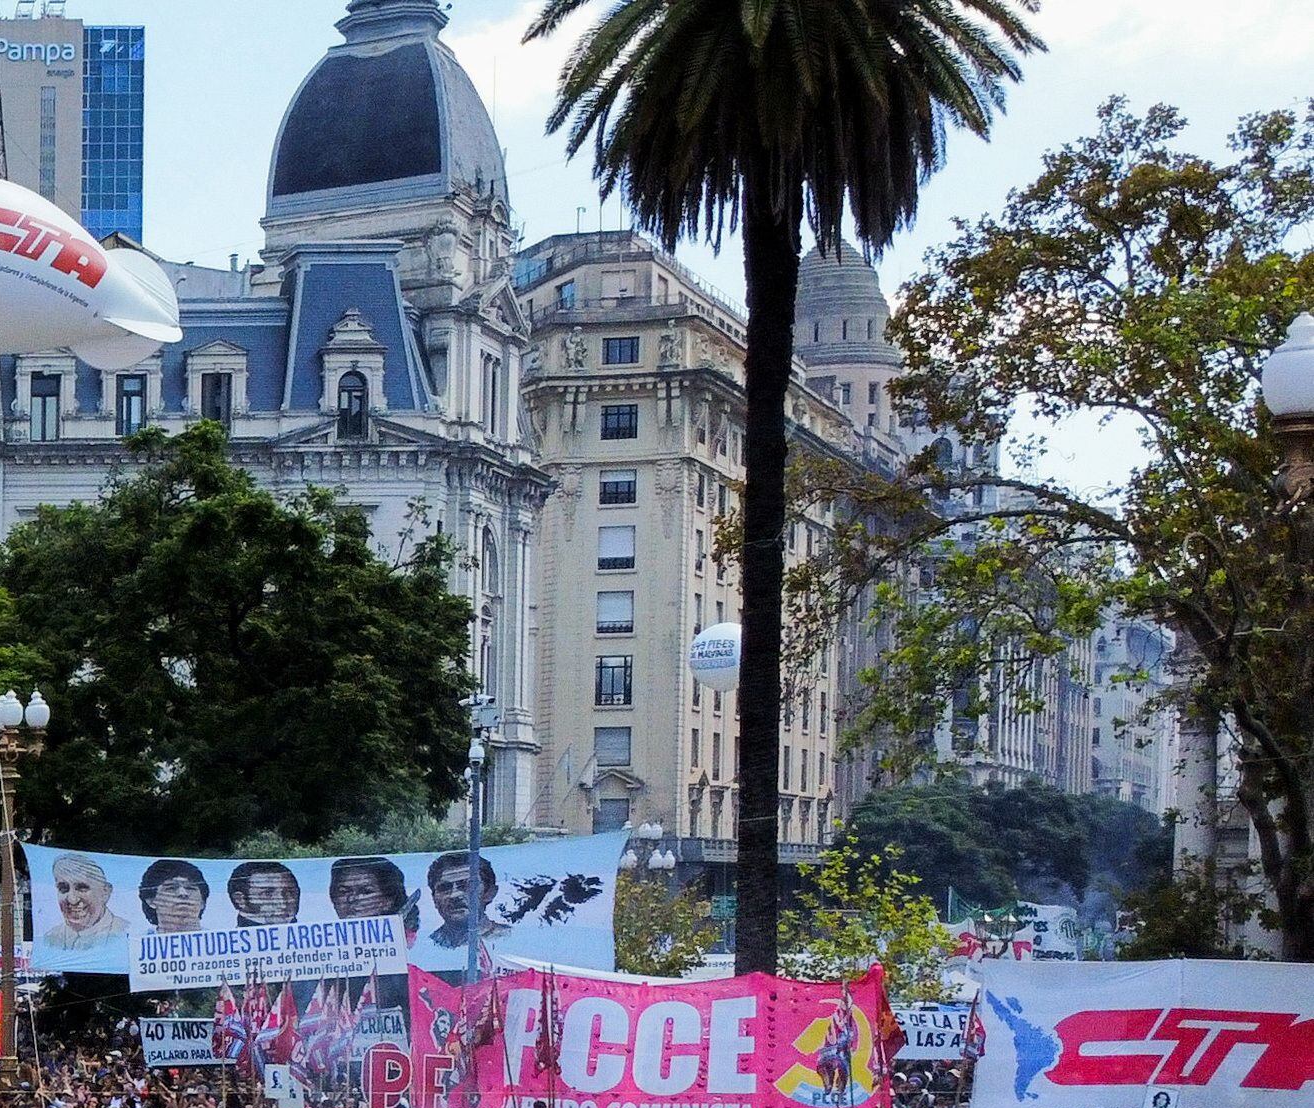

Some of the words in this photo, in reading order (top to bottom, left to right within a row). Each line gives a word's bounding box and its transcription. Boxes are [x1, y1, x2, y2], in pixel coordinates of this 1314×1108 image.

[138, 928, 251, 962] JUVENTUDES
[257, 926, 281, 952] DE
[285, 918, 395, 950] ARGENTINA
[138, 960, 187, 975] 30.000
[190, 959, 241, 971] razones
[277, 950, 334, 964] defender
[338, 949, 349, 961] la
[355, 945, 397, 960] Patria
[909, 1013, 927, 1028] DE
[932, 1014, 953, 1030] LA
[145, 1022, 165, 1042] 40
[503, 988, 758, 1096] PCCE
[916, 1032, 946, 1048] LAS
[190, 1049, 213, 1060] PARA
